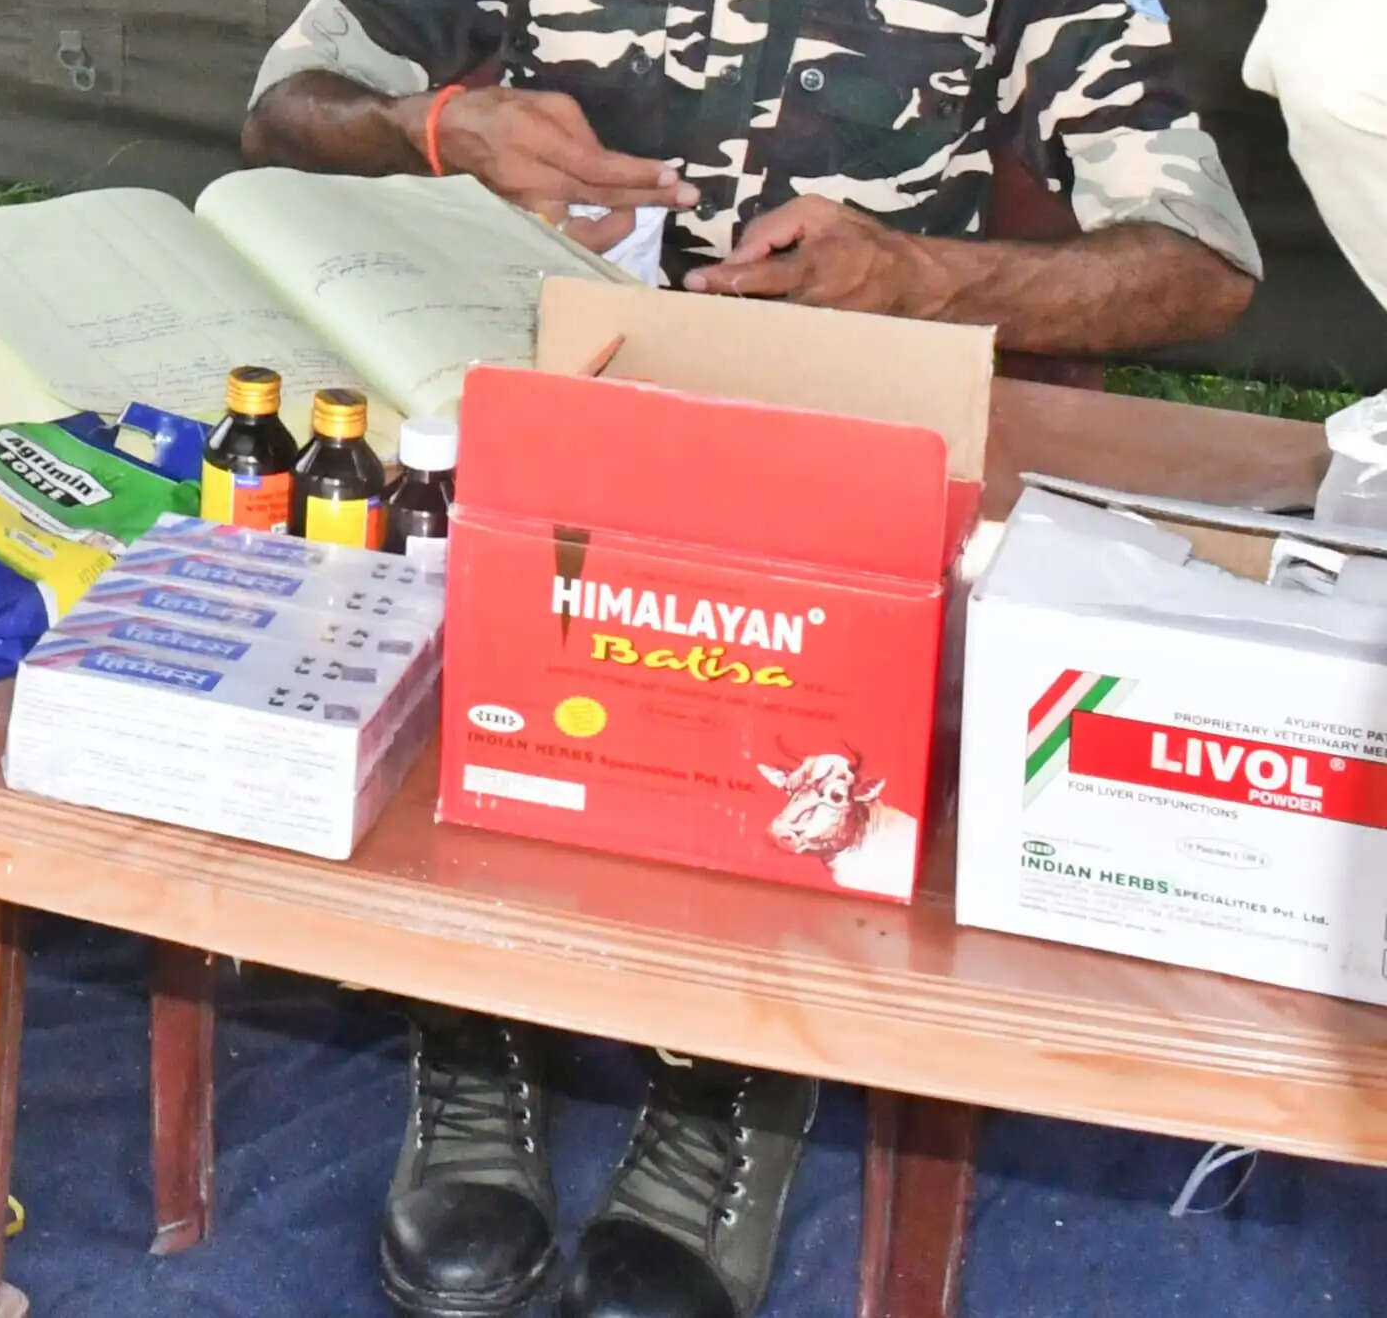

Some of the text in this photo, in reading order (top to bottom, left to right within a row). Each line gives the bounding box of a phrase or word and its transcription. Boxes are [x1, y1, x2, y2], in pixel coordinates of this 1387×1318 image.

[5, 436, 94, 497] Agrimin
[552, 574, 804, 654] HIMALAYAN
[589, 633, 794, 688] Batisa
[467, 731, 528, 751] INDIAN
[535, 742, 595, 763] HERBS
[1174, 712, 1269, 738] PROPRIETARY
[1274, 729, 1360, 754] VETERINARY
[1283, 716, 1364, 738] AYURVEDIC
[1151, 731, 1323, 798] LIVOL
[1067, 780, 1239, 821] FOR LIVER DYSFUNCTIONS
[1248, 788, 1323, 813] POWDER
[1020, 854, 1093, 881] INDIAN
[1099, 869, 1170, 895] HERBS
[1174, 887, 1268, 914] SPECIALITIES
[1302, 912, 1331, 927] Ltd.
